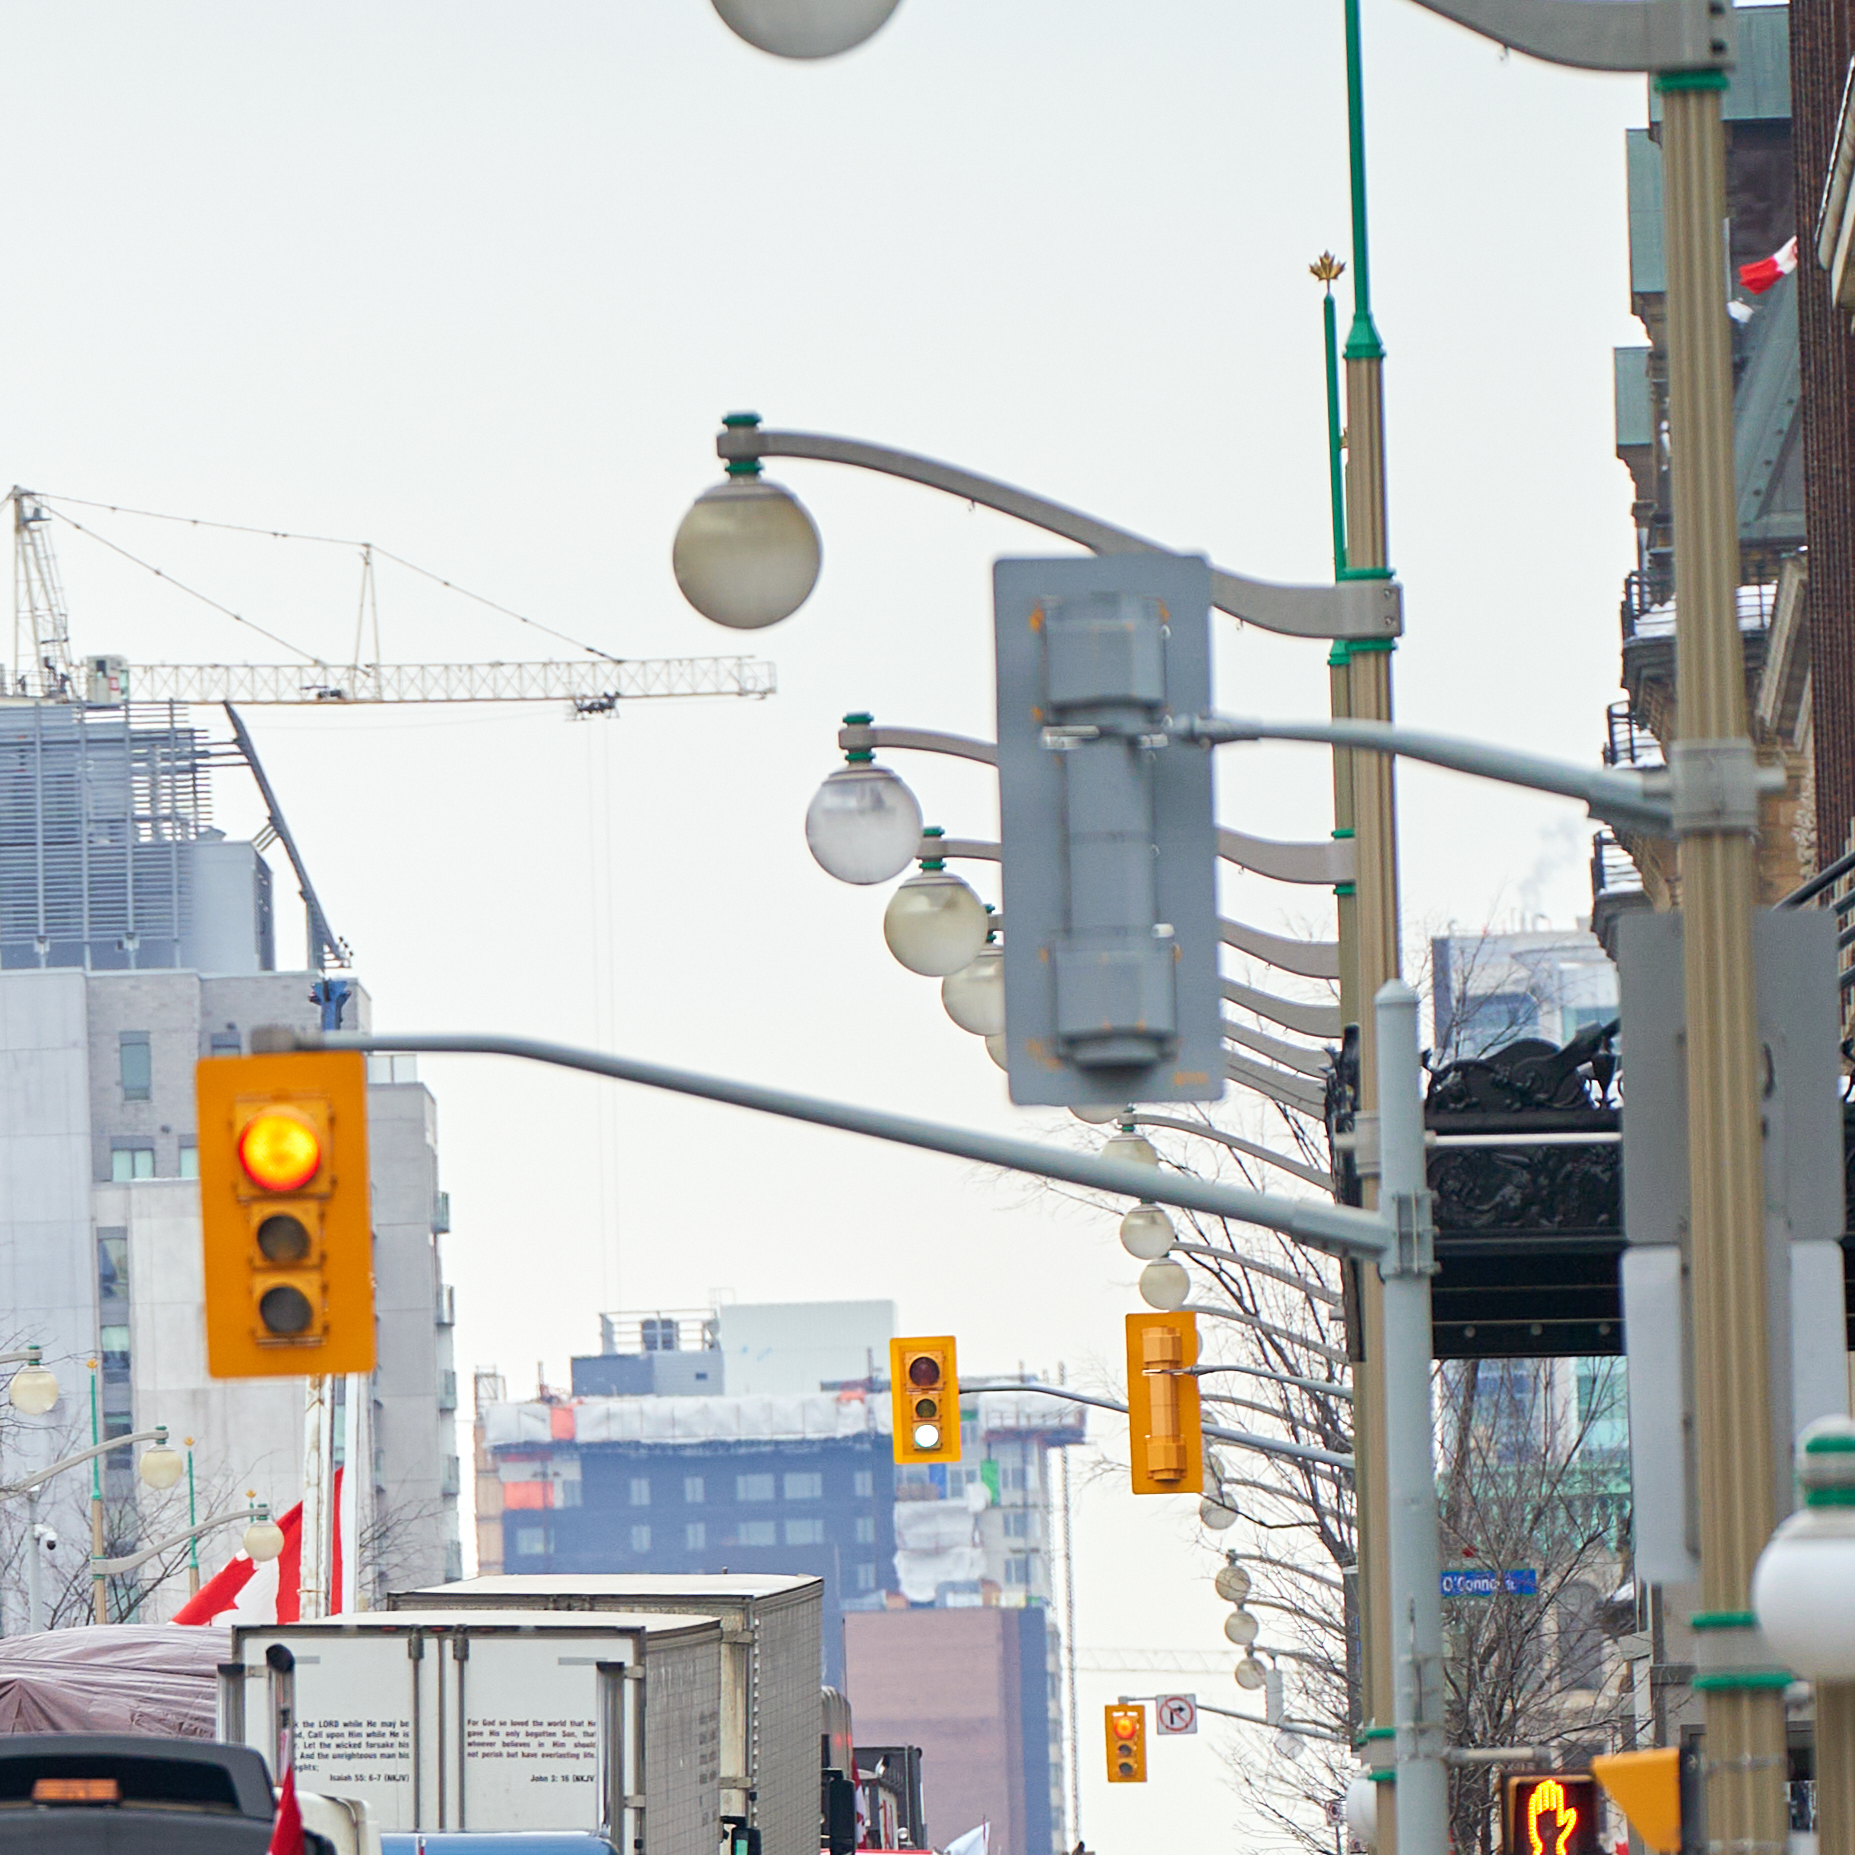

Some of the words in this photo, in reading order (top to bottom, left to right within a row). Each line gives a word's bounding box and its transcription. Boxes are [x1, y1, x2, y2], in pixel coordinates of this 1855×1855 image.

[1443, 1576, 1503, 1592] O'Conno
[319, 1720, 339, 1728] LORD
[367, 1720, 377, 1728] He
[381, 1720, 396, 1729] may
[400, 1720, 409, 1728] be
[525, 1730, 556, 1738] begotten
[541, 1752, 580, 1760] everlasting
[530, 1774, 548, 1782] John
